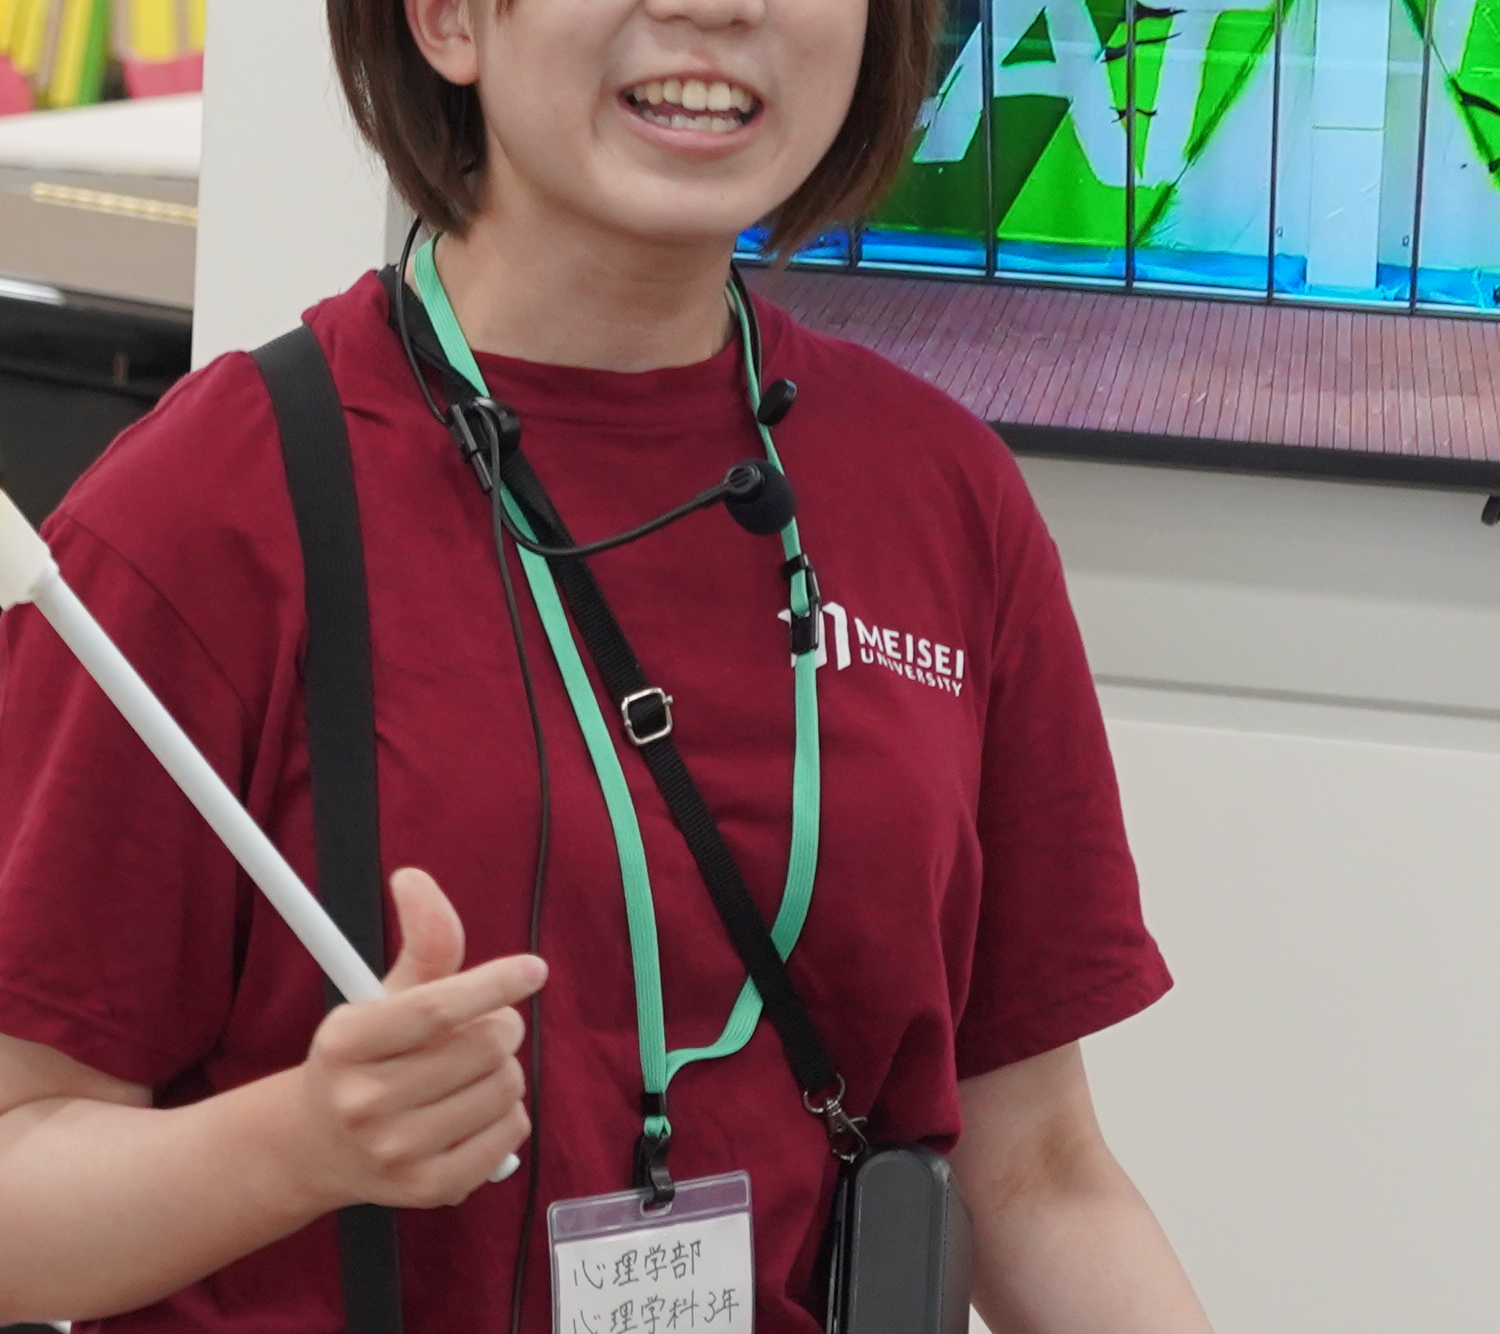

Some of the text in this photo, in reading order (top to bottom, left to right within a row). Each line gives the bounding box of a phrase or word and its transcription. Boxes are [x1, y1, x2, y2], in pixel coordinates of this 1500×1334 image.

[854, 616, 965, 679] MEISEI
[860, 647, 963, 697] UNIVERSITY
[573, 1240, 702, 1289] 心理学部
